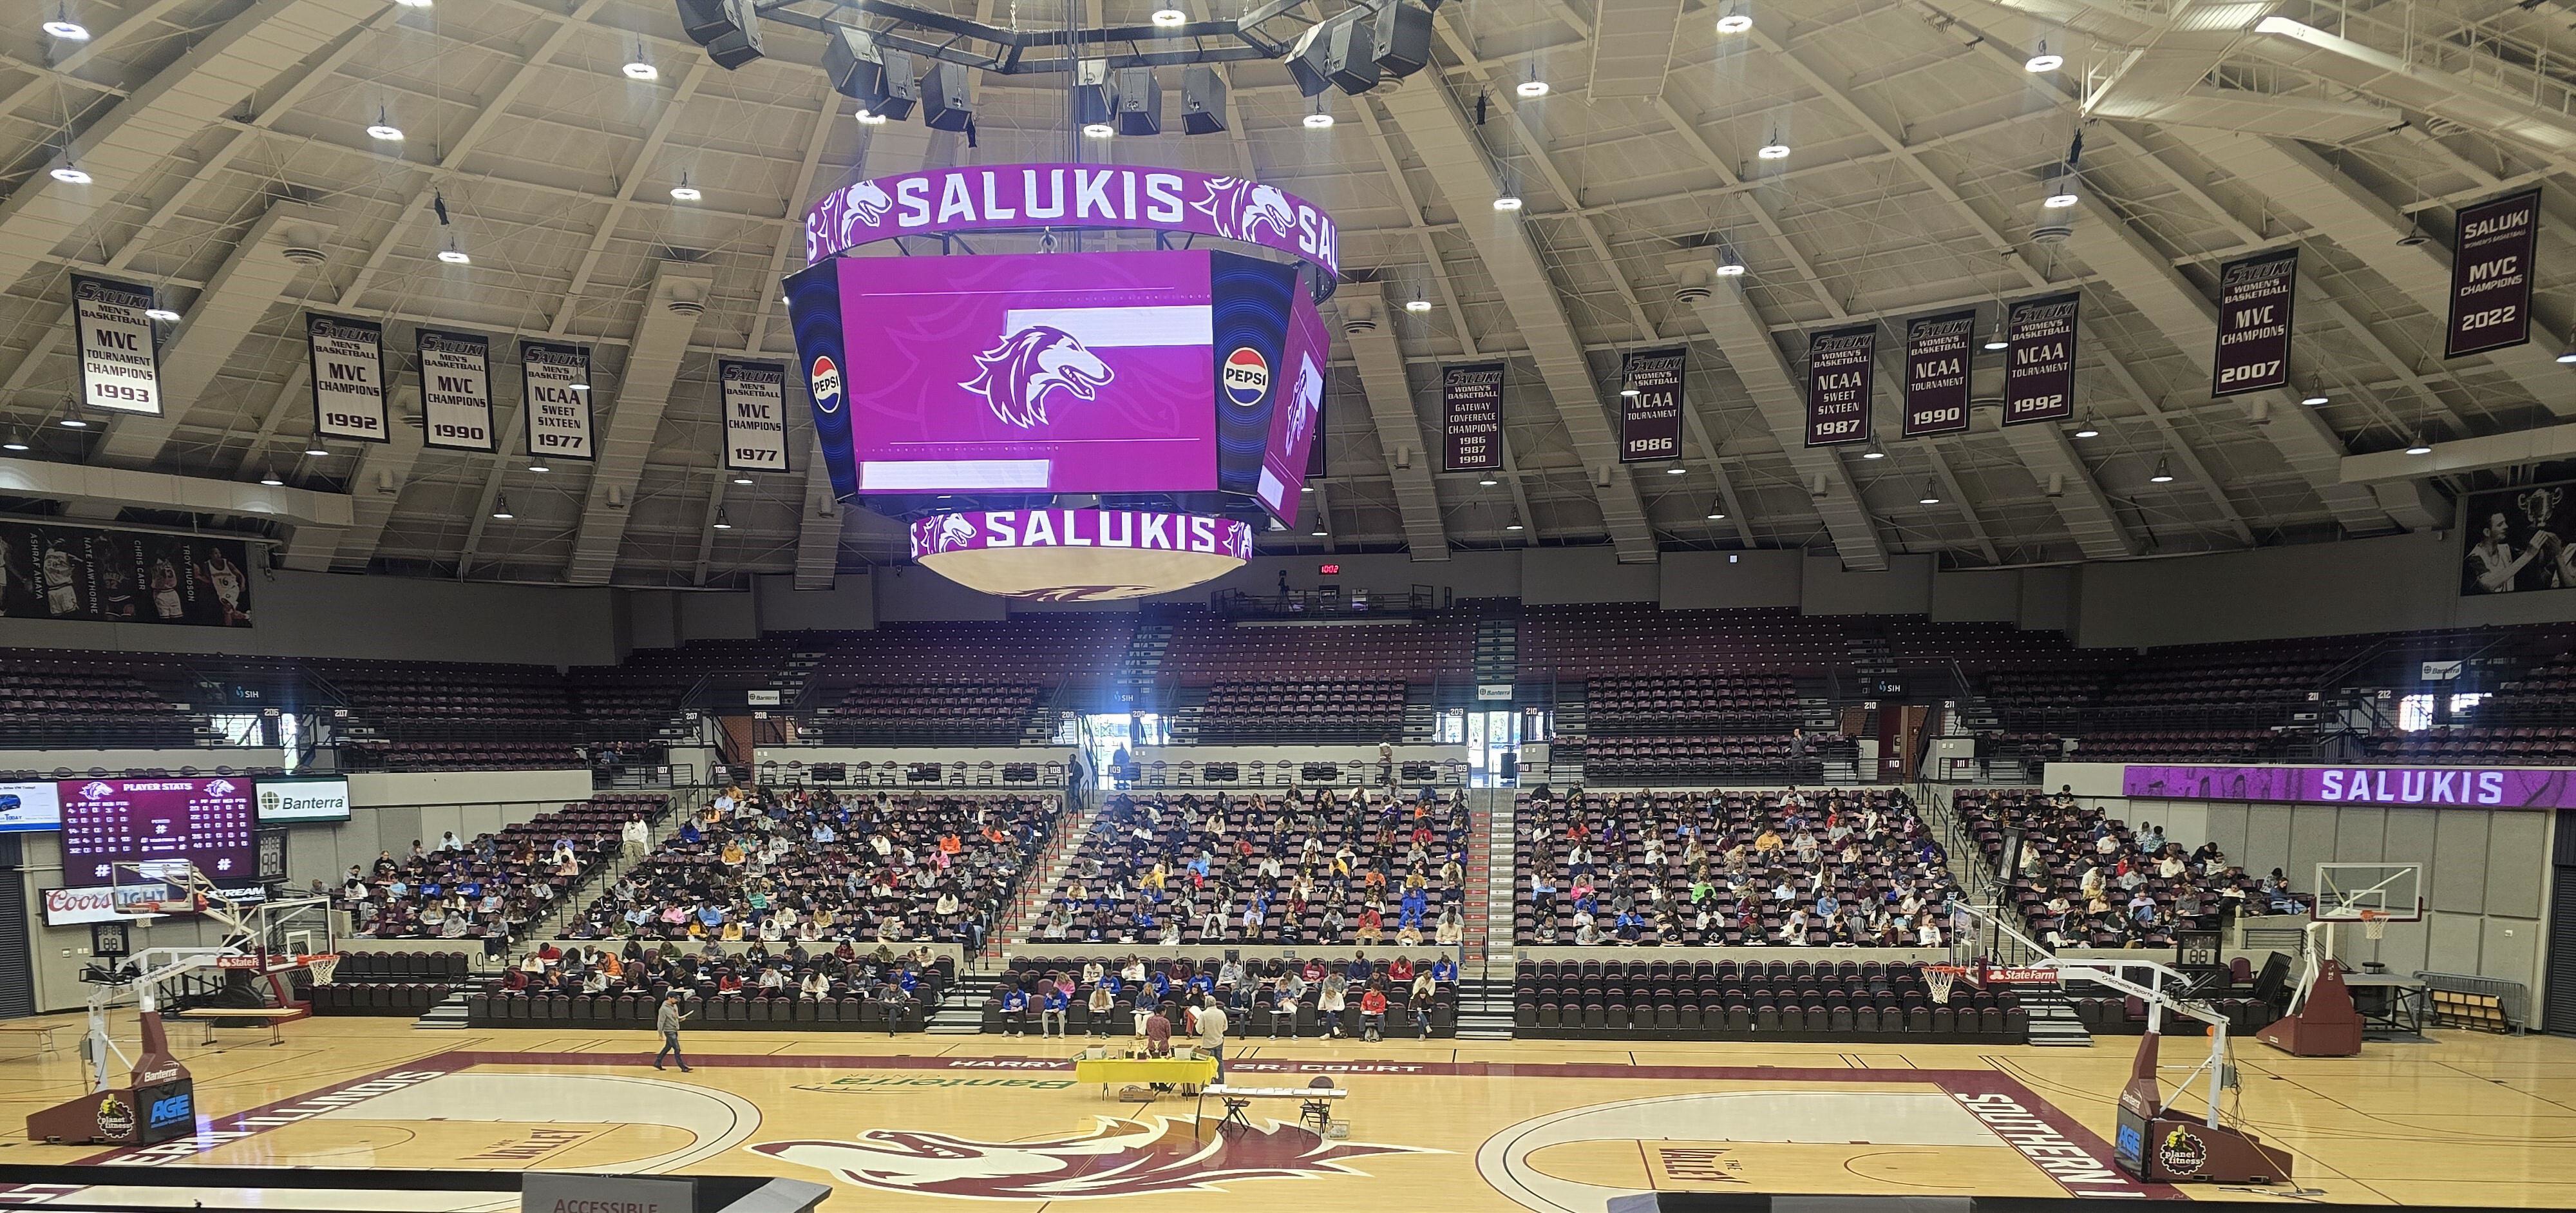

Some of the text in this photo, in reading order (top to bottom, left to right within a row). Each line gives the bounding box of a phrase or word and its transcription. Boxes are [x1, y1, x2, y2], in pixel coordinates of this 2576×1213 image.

[897, 169, 1185, 228] SALUKIS
[2465, 209, 2529, 240] SALUKI
[1298, 205, 1338, 278] SAL
[2222, 257, 2296, 287] SALUKI
[2469, 256, 2517, 283] MVC
[2234, 278, 2280, 293] WOMEN'S
[2461, 274, 2523, 297] CHAMPIONS
[73, 280, 151, 309] SALUKI
[2225, 285, 2288, 304] BASKETBALL
[81, 310, 149, 327] BASKETBALL
[99, 305, 130, 316] MEN'S
[2009, 300, 2078, 326] SALUKI
[2235, 305, 2274, 329] MVC
[2462, 305, 2515, 331] 2022
[309, 318, 379, 344] SALUKI
[1908, 318, 1975, 341] SALUKI
[2012, 325, 2070, 341] BASKETBALL
[2021, 319, 2063, 332] WOMEN'S
[96, 329, 138, 351] MVC
[1810, 332, 1875, 354] SALUKI
[1919, 335, 1959, 347] WOMEN'S
[2222, 325, 2284, 345] CHAMPIONS
[316, 346, 377, 359] BASKETBALL
[331, 340, 360, 350] MEN'S
[419, 333, 488, 356] SALUKI
[1911, 341, 1967, 356] BASKETBALL
[86, 349, 151, 366] TOURNAMENT
[439, 354, 467, 363] MEN'S
[523, 347, 589, 367] SALUKI
[1814, 356, 1868, 368] BASKETBALL
[1822, 349, 1861, 360] WOMEN'S
[2017, 343, 2064, 365] NCAA
[87, 363, 153, 380] CHAMPIONS
[329, 363, 366, 382] MVC
[425, 359, 484, 372] BASKETBALL
[721, 365, 783, 383] SALUKI
[1916, 358, 1960, 379] NCAA
[2012, 362, 2069, 378] TOURNAMENT
[2221, 360, 2280, 383] 2007
[529, 372, 574, 381] BASKETBA
[1226, 367, 1266, 386] PEPSI
[1444, 369, 1503, 387] SALUKI
[1634, 371, 1672, 380] WOMEN'S
[1634, 377, 1679, 387] ASKETBALL
[1818, 372, 1862, 391] NCAA
[95, 383, 149, 403] 1993
[319, 381, 379, 396] CHAMPIONS
[438, 376, 473, 394] MVC
[814, 376, 839, 394] PEPSI
[1911, 377, 1964, 392] TOURNAMENT
[428, 394, 486, 407] CHAMPIONS
[535, 387, 581, 405] NCAA
[727, 389, 780, 398] BASKETBALL
[1448, 391, 1497, 399] BASKETBALL
[1631, 392, 1673, 409] NCAA
[1824, 390, 1855, 403] SWEET
[542, 405, 575, 416] SWEET
[738, 403, 770, 419] MVC
[1455, 402, 1491, 412] GATEWAY
[1818, 402, 1859, 415] SIXTEEN
[2014, 394, 2062, 413] 1992
[326, 413, 377, 430] 1992
[538, 417, 581, 428] SIXTEEN
[1450, 412, 1495, 423] CONFERENCE
[1628, 410, 1676, 421] TOURNAMENT
[1913, 407, 1960, 425] 1990
[434, 425, 484, 439] 1990
[729, 420, 781, 431] CHAMPIONS
[1449, 423, 1497, 434] CHAMPIONS
[1816, 420, 1860, 435] 1987
[538, 434, 583, 448] 1977
[1460, 436, 1486, 444] 1986
[1629, 438, 1672, 452] 1986
[735, 448, 777, 461] 1977
[1460, 446, 1486, 454] 1987
[1459, 455, 1486, 464] 1990
[985, 511, 1215, 553] SALUKIS
[30, 532, 41, 573] ASHRAF
[134, 540, 146, 590] CHRIS CARR
[84, 537, 98, 614] NATE HAWTHORNE
[185, 568, 194, 602] HUDSON
[2308, 692, 2318, 701] 211
[2378, 690, 2391, 698] 212
[1455, 764, 1468, 772] 109
[1520, 763, 1529, 772] 110
[2321, 770, 2503, 804] SALUKIS
[283, 798, 343, 809] Banterra
[47, 890, 164, 912] Coors IGHT
[231, 958, 260, 966] StateFa
[2004, 970, 2054, 980] StateFarm
[2132, 986, 2154, 997] Sports
[144, 1069, 178, 1082] Banterra
[831, 1077, 1078, 1089] Banterra
[231, 1071, 446, 1126] ILLINOIS
[151, 1094, 189, 1122] AGE
[455, 1129, 593, 1160] VALLEY
[1954, 1094, 2129, 1184] SOUTHERN
[2118, 1124, 2140, 1157] AGE
[1659, 1149, 1752, 1184] VALLEY
